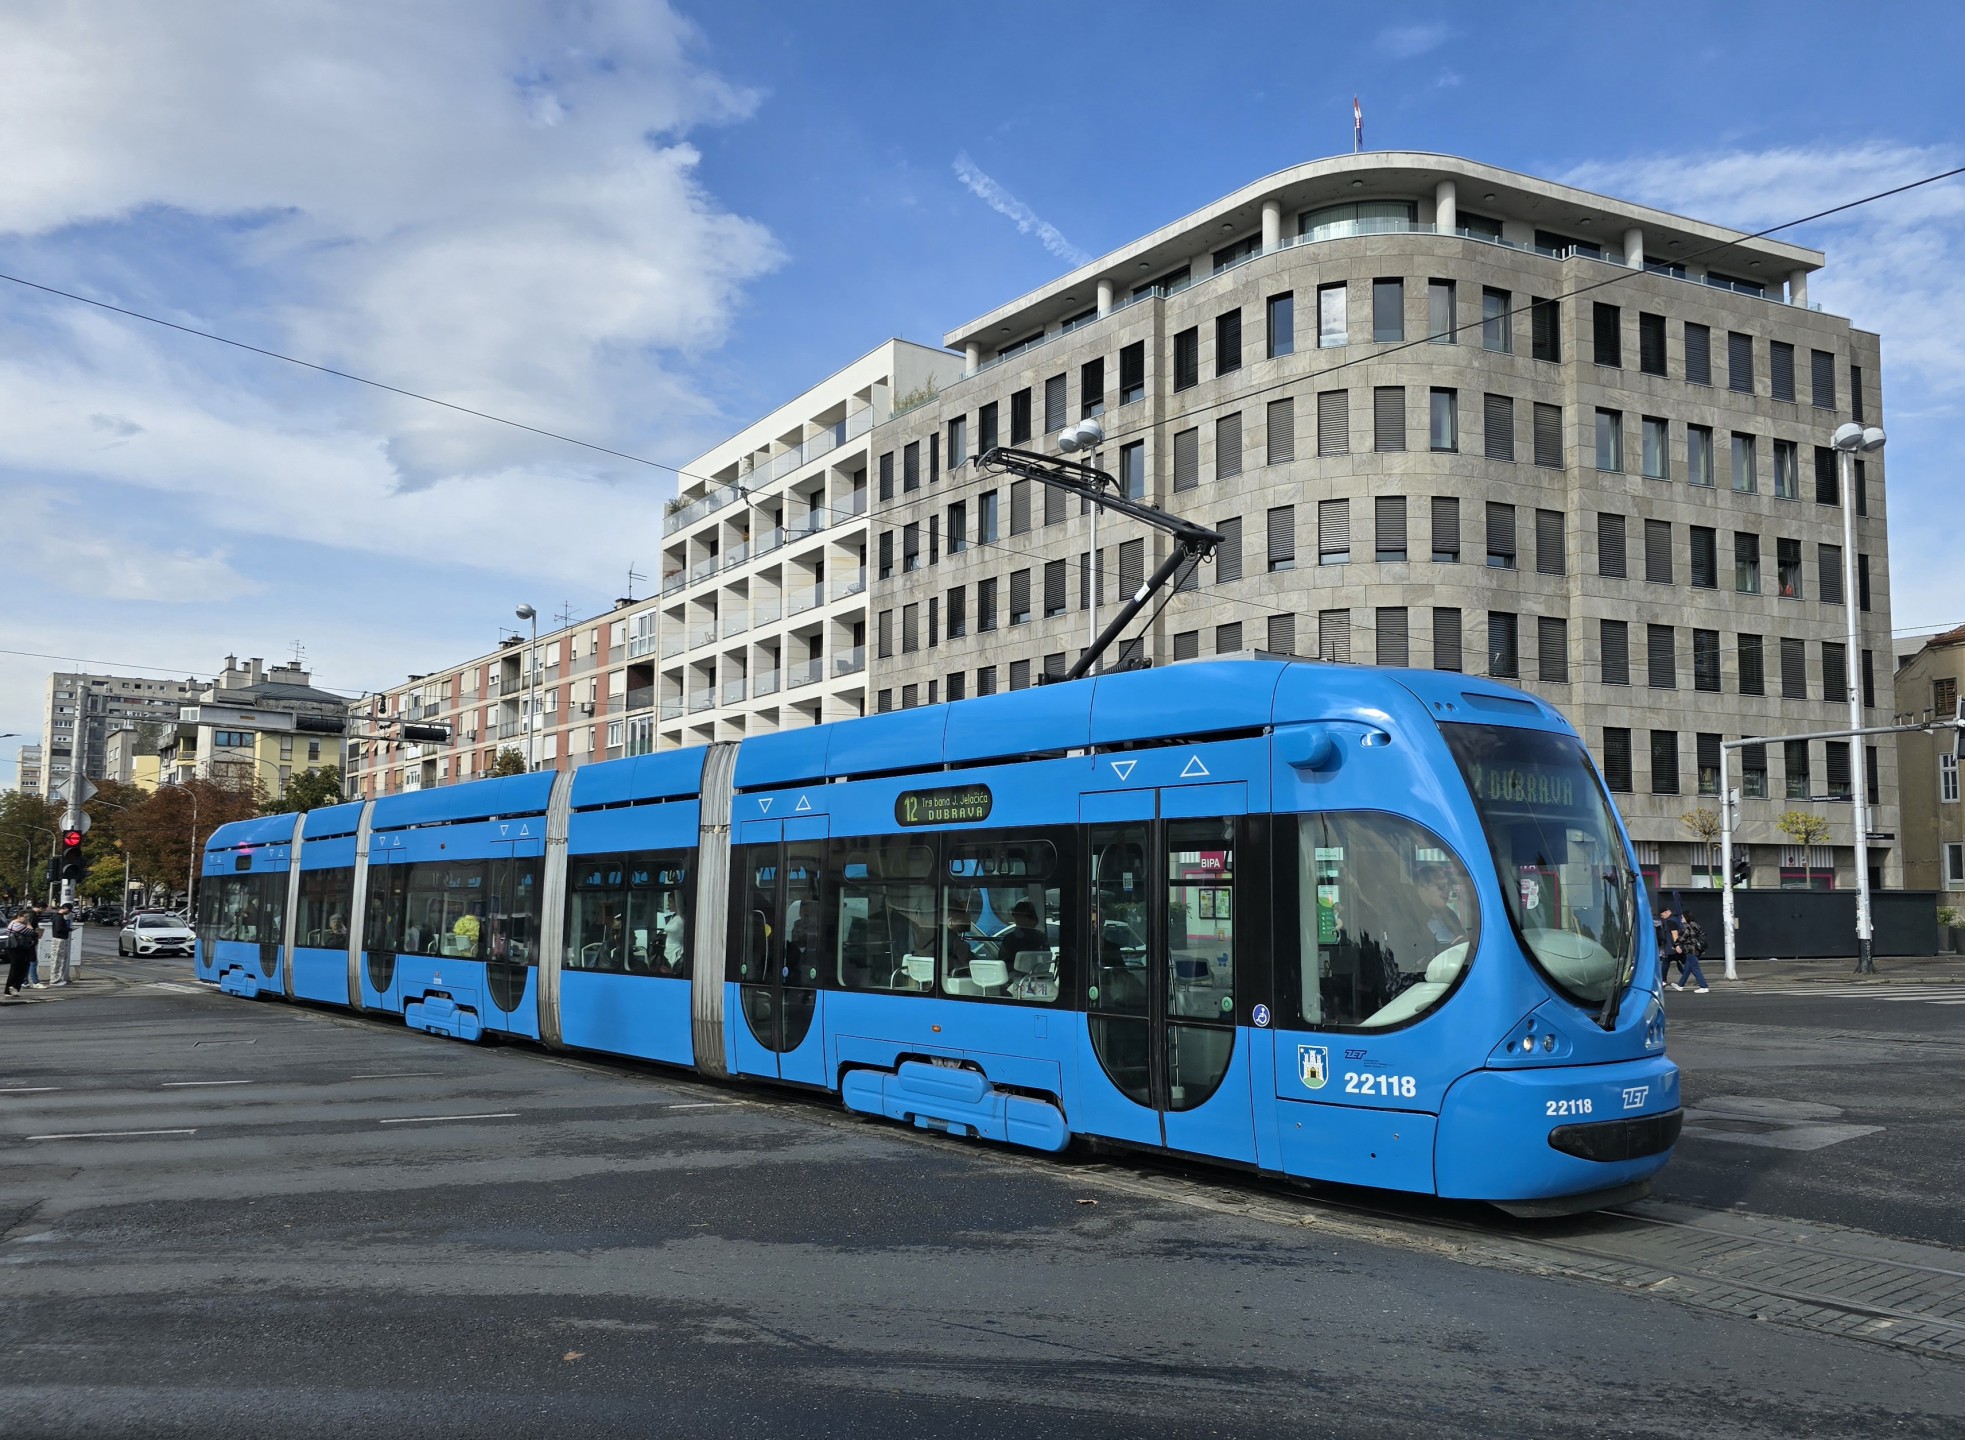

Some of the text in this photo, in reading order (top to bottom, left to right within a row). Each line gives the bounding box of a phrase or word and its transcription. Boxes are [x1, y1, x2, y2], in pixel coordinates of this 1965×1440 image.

[1490, 769, 1573, 806] DUBRAVA
[904, 796, 918, 822] 12
[922, 797, 933, 807] Trg
[934, 797, 951, 807] bana
[928, 807, 983, 820] DUBRAVA
[1201, 858, 1220, 868] BIPA
[1345, 1050, 1367, 1059] ZET
[1344, 1072, 1417, 1098] 22118
[1622, 1086, 1649, 1109] ZET
[1546, 1098, 1592, 1116] 22118
